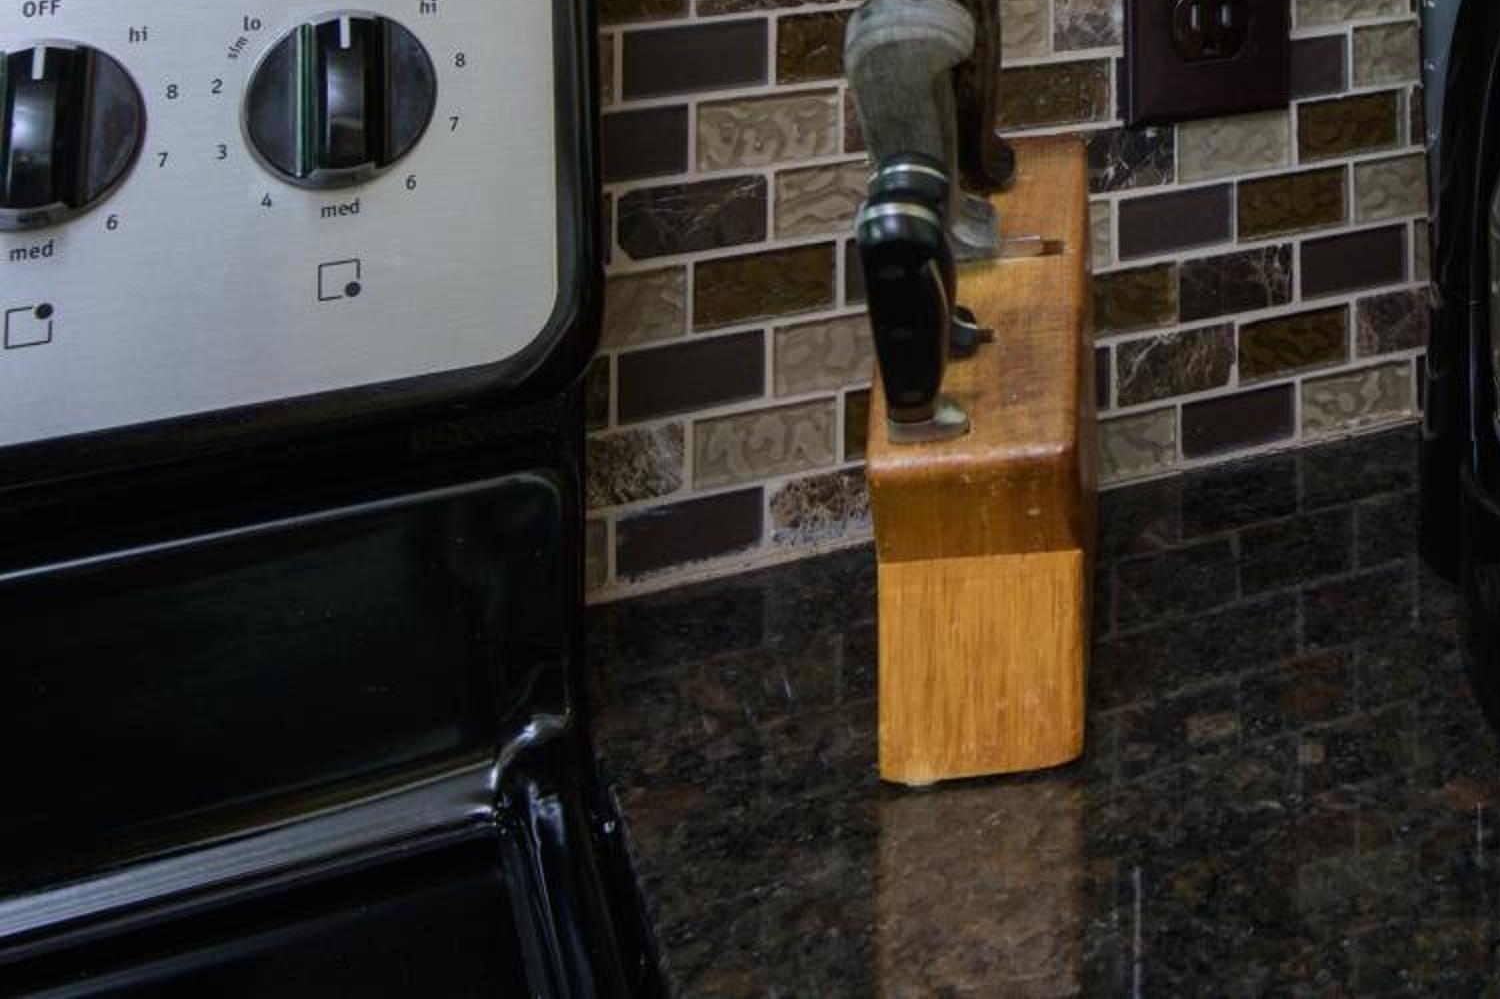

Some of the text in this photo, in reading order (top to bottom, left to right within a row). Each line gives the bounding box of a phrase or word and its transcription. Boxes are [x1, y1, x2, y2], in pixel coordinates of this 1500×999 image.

[243, 15, 262, 32] lo
[128, 25, 148, 43] hi
[454, 52, 467, 69] 8
[165, 83, 180, 100] 8
[211, 77, 223, 94] 2
[449, 115, 460, 132] 7
[157, 151, 169, 168] 7
[216, 144, 228, 161] 3
[405, 174, 417, 191] 6
[260, 192, 273, 209] 4
[320, 198, 361, 218] med
[105, 213, 119, 231] 6
[9, 240, 55, 262] med
